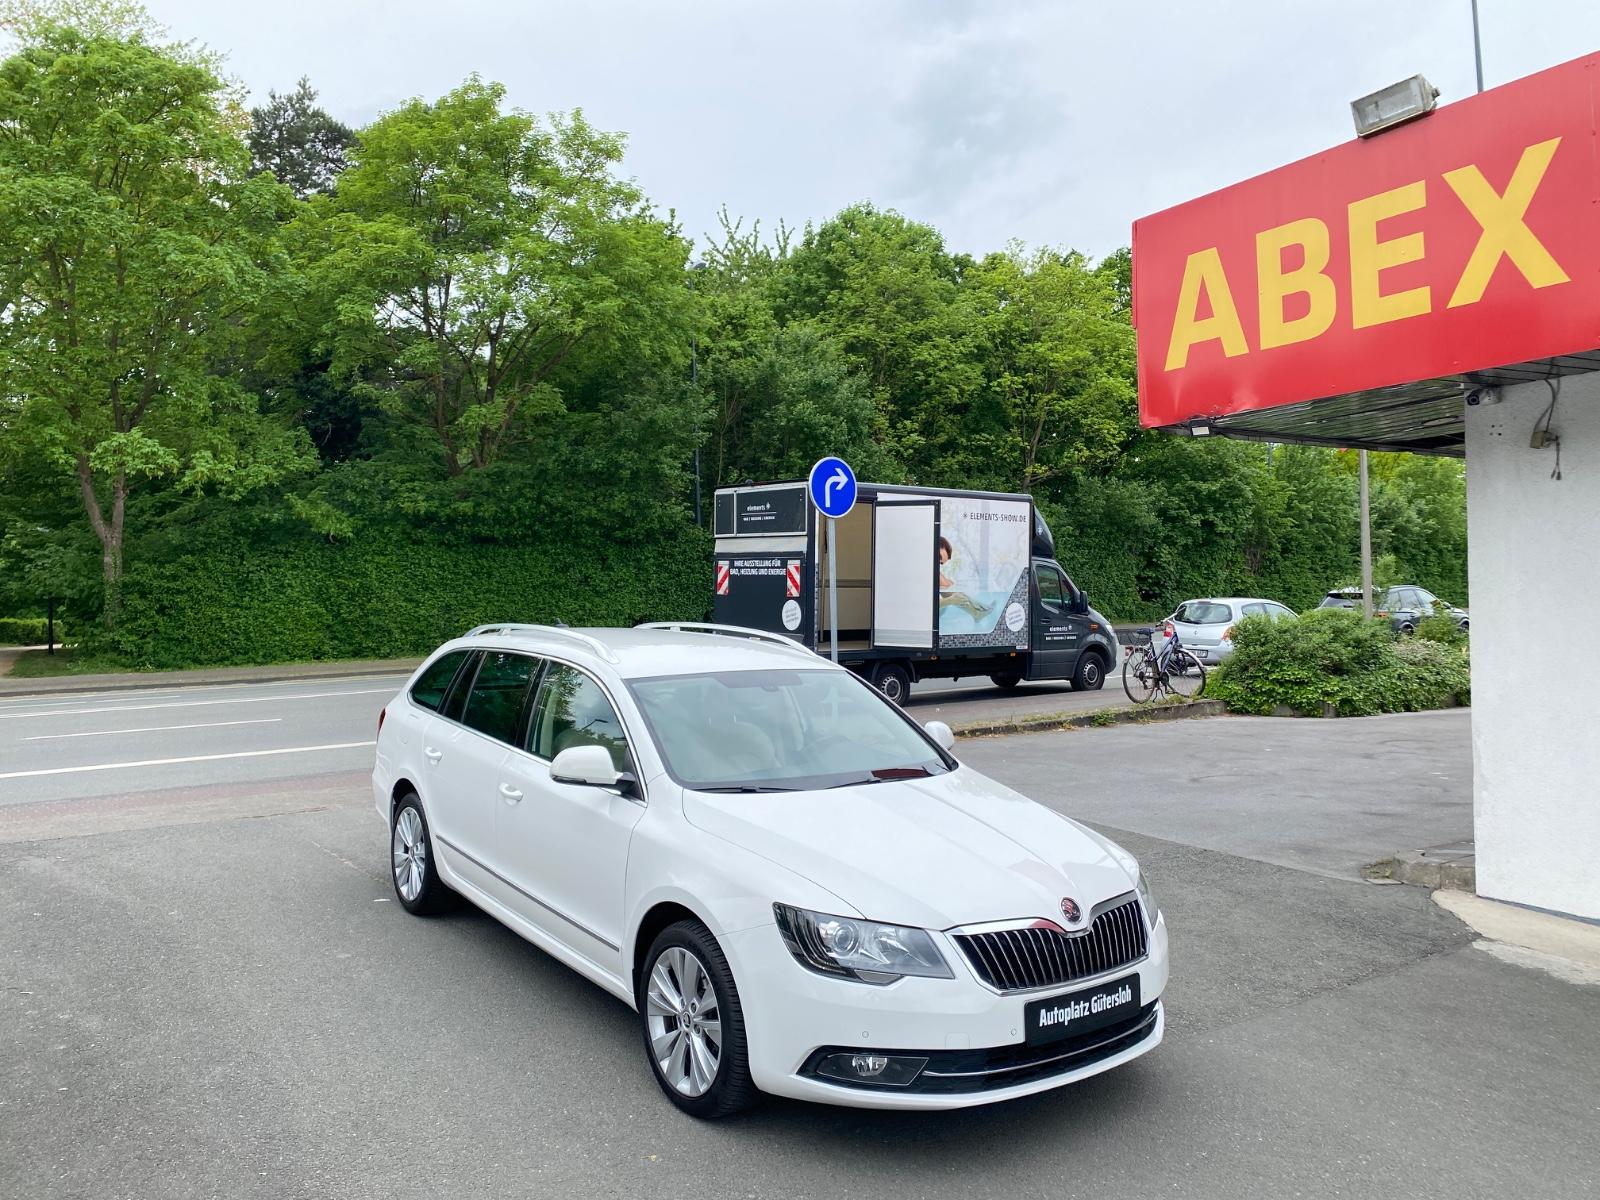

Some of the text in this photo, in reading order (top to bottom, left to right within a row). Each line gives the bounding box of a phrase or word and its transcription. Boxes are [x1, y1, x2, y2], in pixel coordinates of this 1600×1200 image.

[1164, 136, 1572, 372] ABEX
[970, 512, 1027, 523] ELEMENTS-SHOW.DE
[1039, 984, 1132, 1026] Autoplatz Gütersloh
